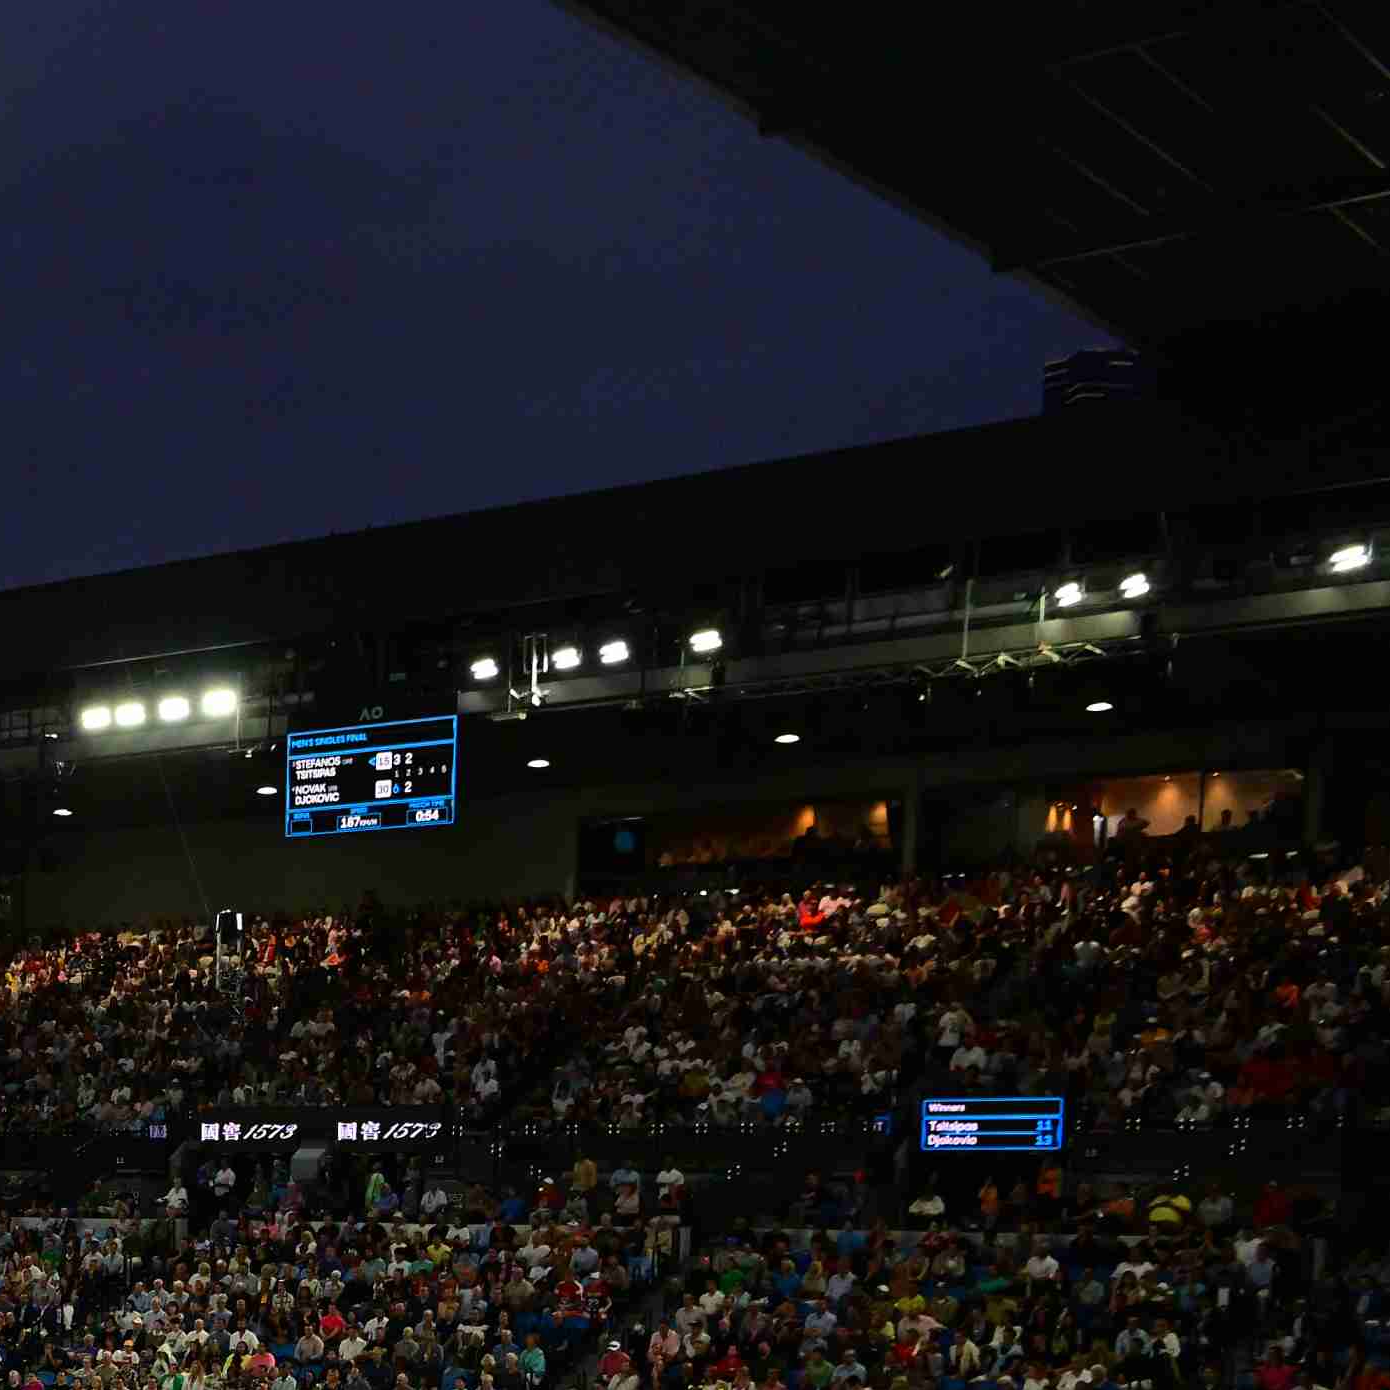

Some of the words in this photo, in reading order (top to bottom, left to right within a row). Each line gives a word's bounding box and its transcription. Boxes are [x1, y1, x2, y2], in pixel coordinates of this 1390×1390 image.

[393, 754, 401, 765] 3
[405, 753, 413, 764] 2
[295, 784, 326, 795] NOVAK
[405, 781, 412, 793] 2
